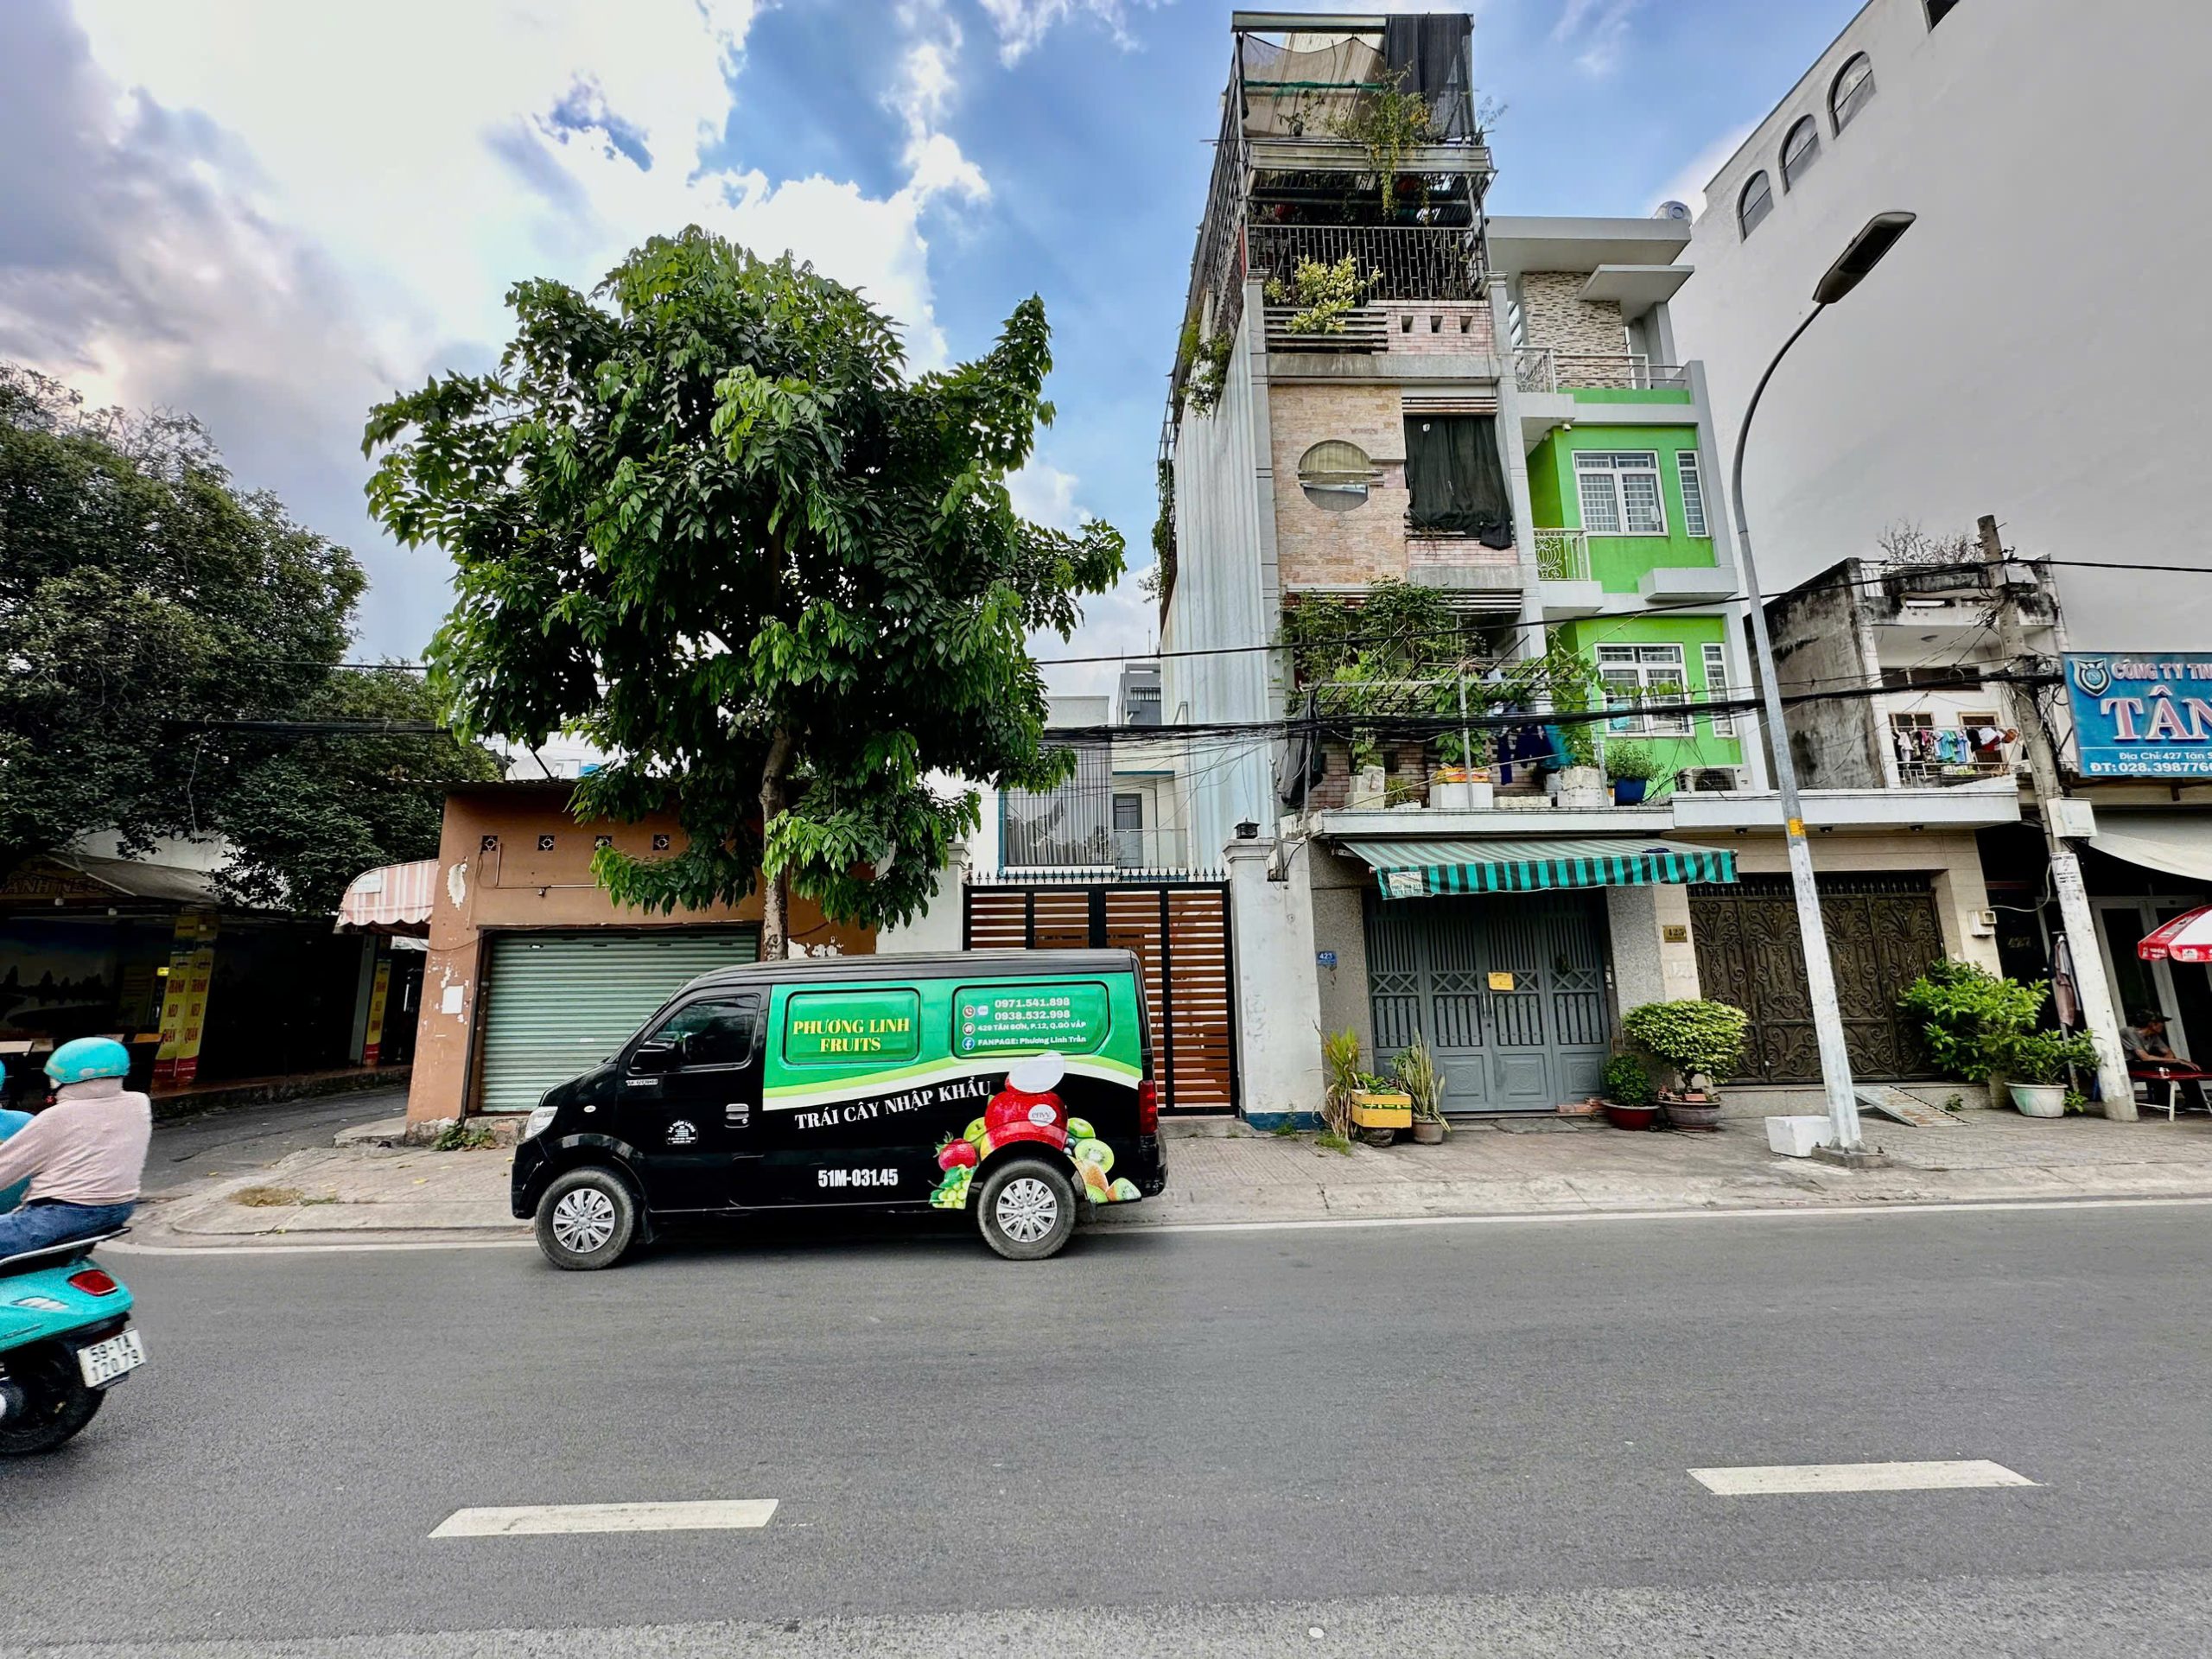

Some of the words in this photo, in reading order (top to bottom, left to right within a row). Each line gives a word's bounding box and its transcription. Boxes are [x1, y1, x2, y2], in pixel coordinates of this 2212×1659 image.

[2111, 658, 2158, 680] CÔNG
[2159, 663, 2183, 679] TY
[2090, 761, 2117, 772] ĐT:
[792, 1018, 864, 1035] PHƯƠNG
[869, 1017, 910, 1033] LINH
[819, 1037, 881, 1052] FRUITS
[794, 1106, 840, 1129] TRÁI
[843, 1101, 880, 1122] CÂY
[884, 1090, 934, 1115] NHẬP
[938, 1077, 991, 1103] KHẨU
[817, 1168, 899, 1187] 51M-031.45
